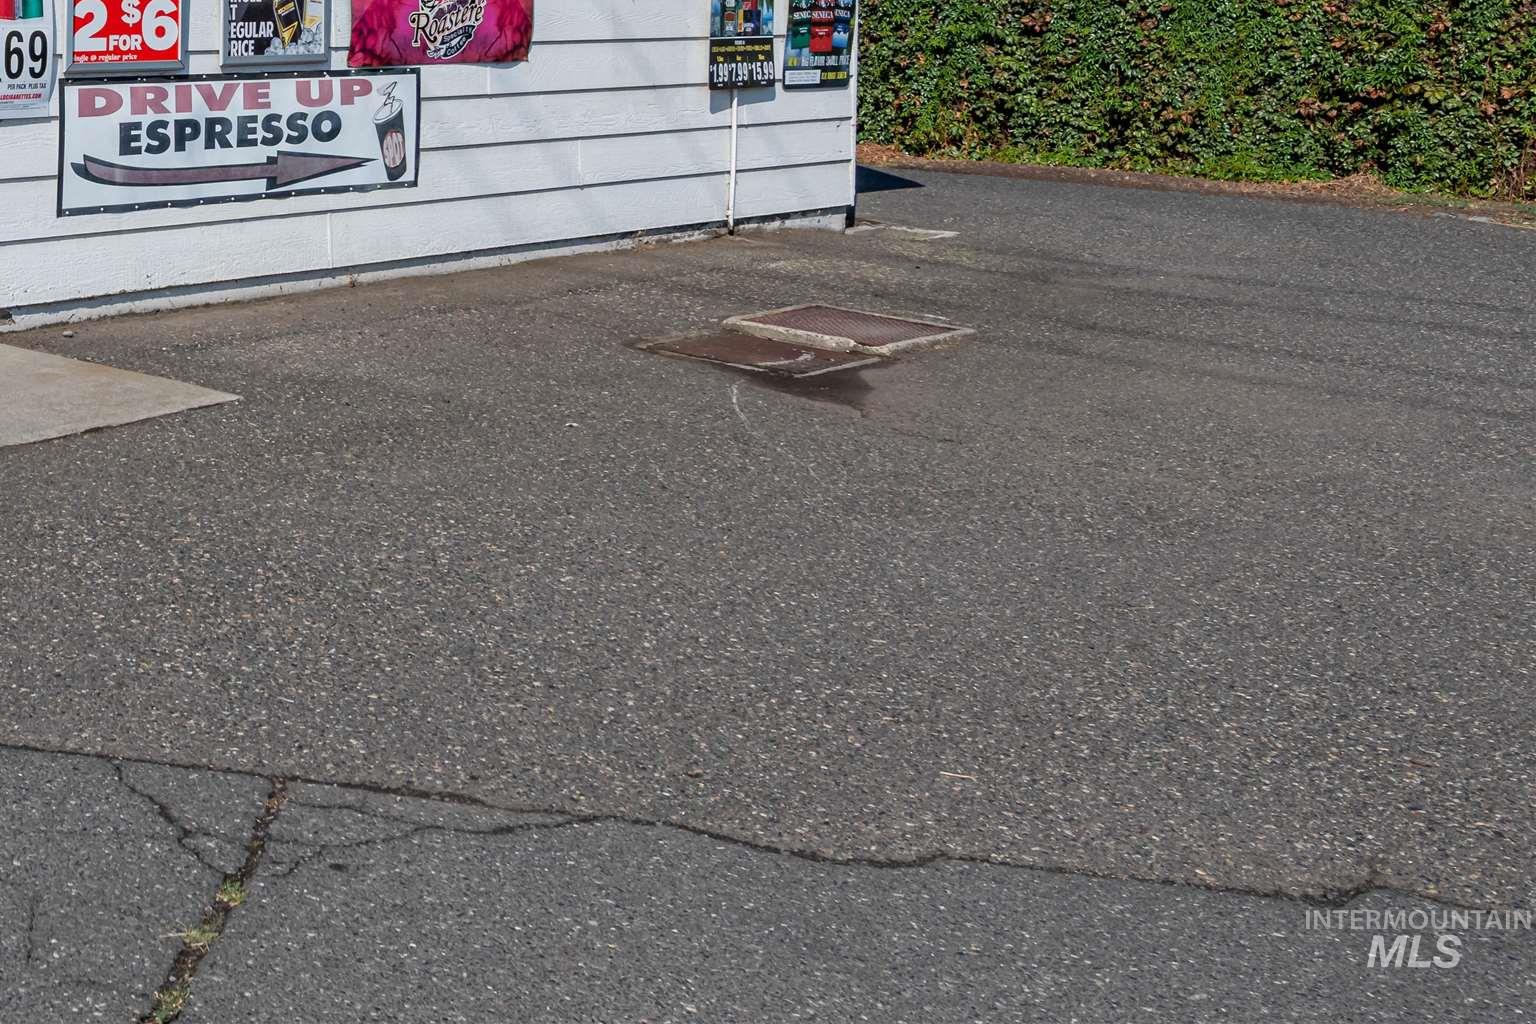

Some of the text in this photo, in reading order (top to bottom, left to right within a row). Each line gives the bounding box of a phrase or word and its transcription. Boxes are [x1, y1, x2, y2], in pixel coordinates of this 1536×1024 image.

[230, 5, 238, 20] T
[793, 10, 811, 20] SENEC
[811, 11, 834, 20] SENECA
[230, 21, 274, 38] EGULAR
[109, 34, 143, 51] FOR
[230, 40, 255, 57] RICE
[74, 53, 89, 64] ingle
[78, 78, 373, 118] DRIVE UP
[118, 111, 342, 156] ESPRESSO
